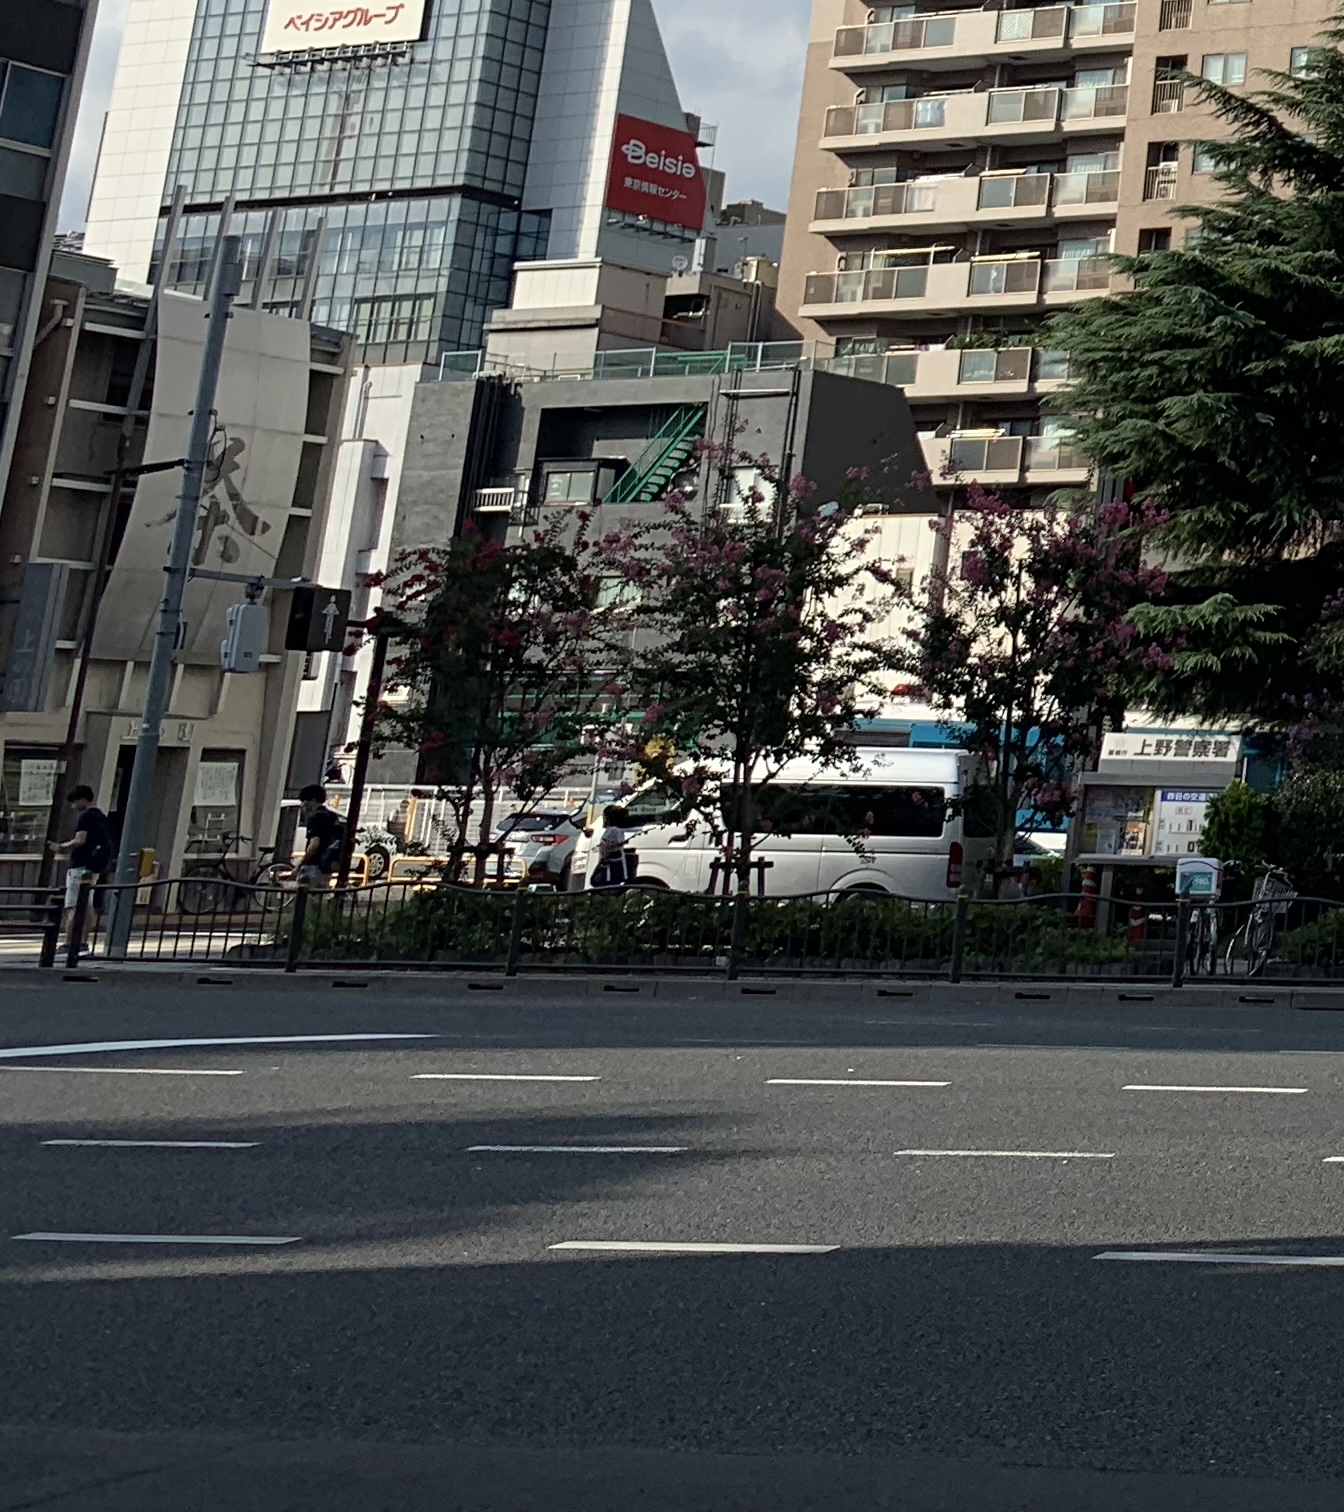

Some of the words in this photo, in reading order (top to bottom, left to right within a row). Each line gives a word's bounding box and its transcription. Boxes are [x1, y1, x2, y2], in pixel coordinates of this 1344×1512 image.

[283, 2, 406, 33] ベイシアグループ
[621, 138, 697, 179] Beisia
[1133, 738, 1231, 758] 上野警察署
